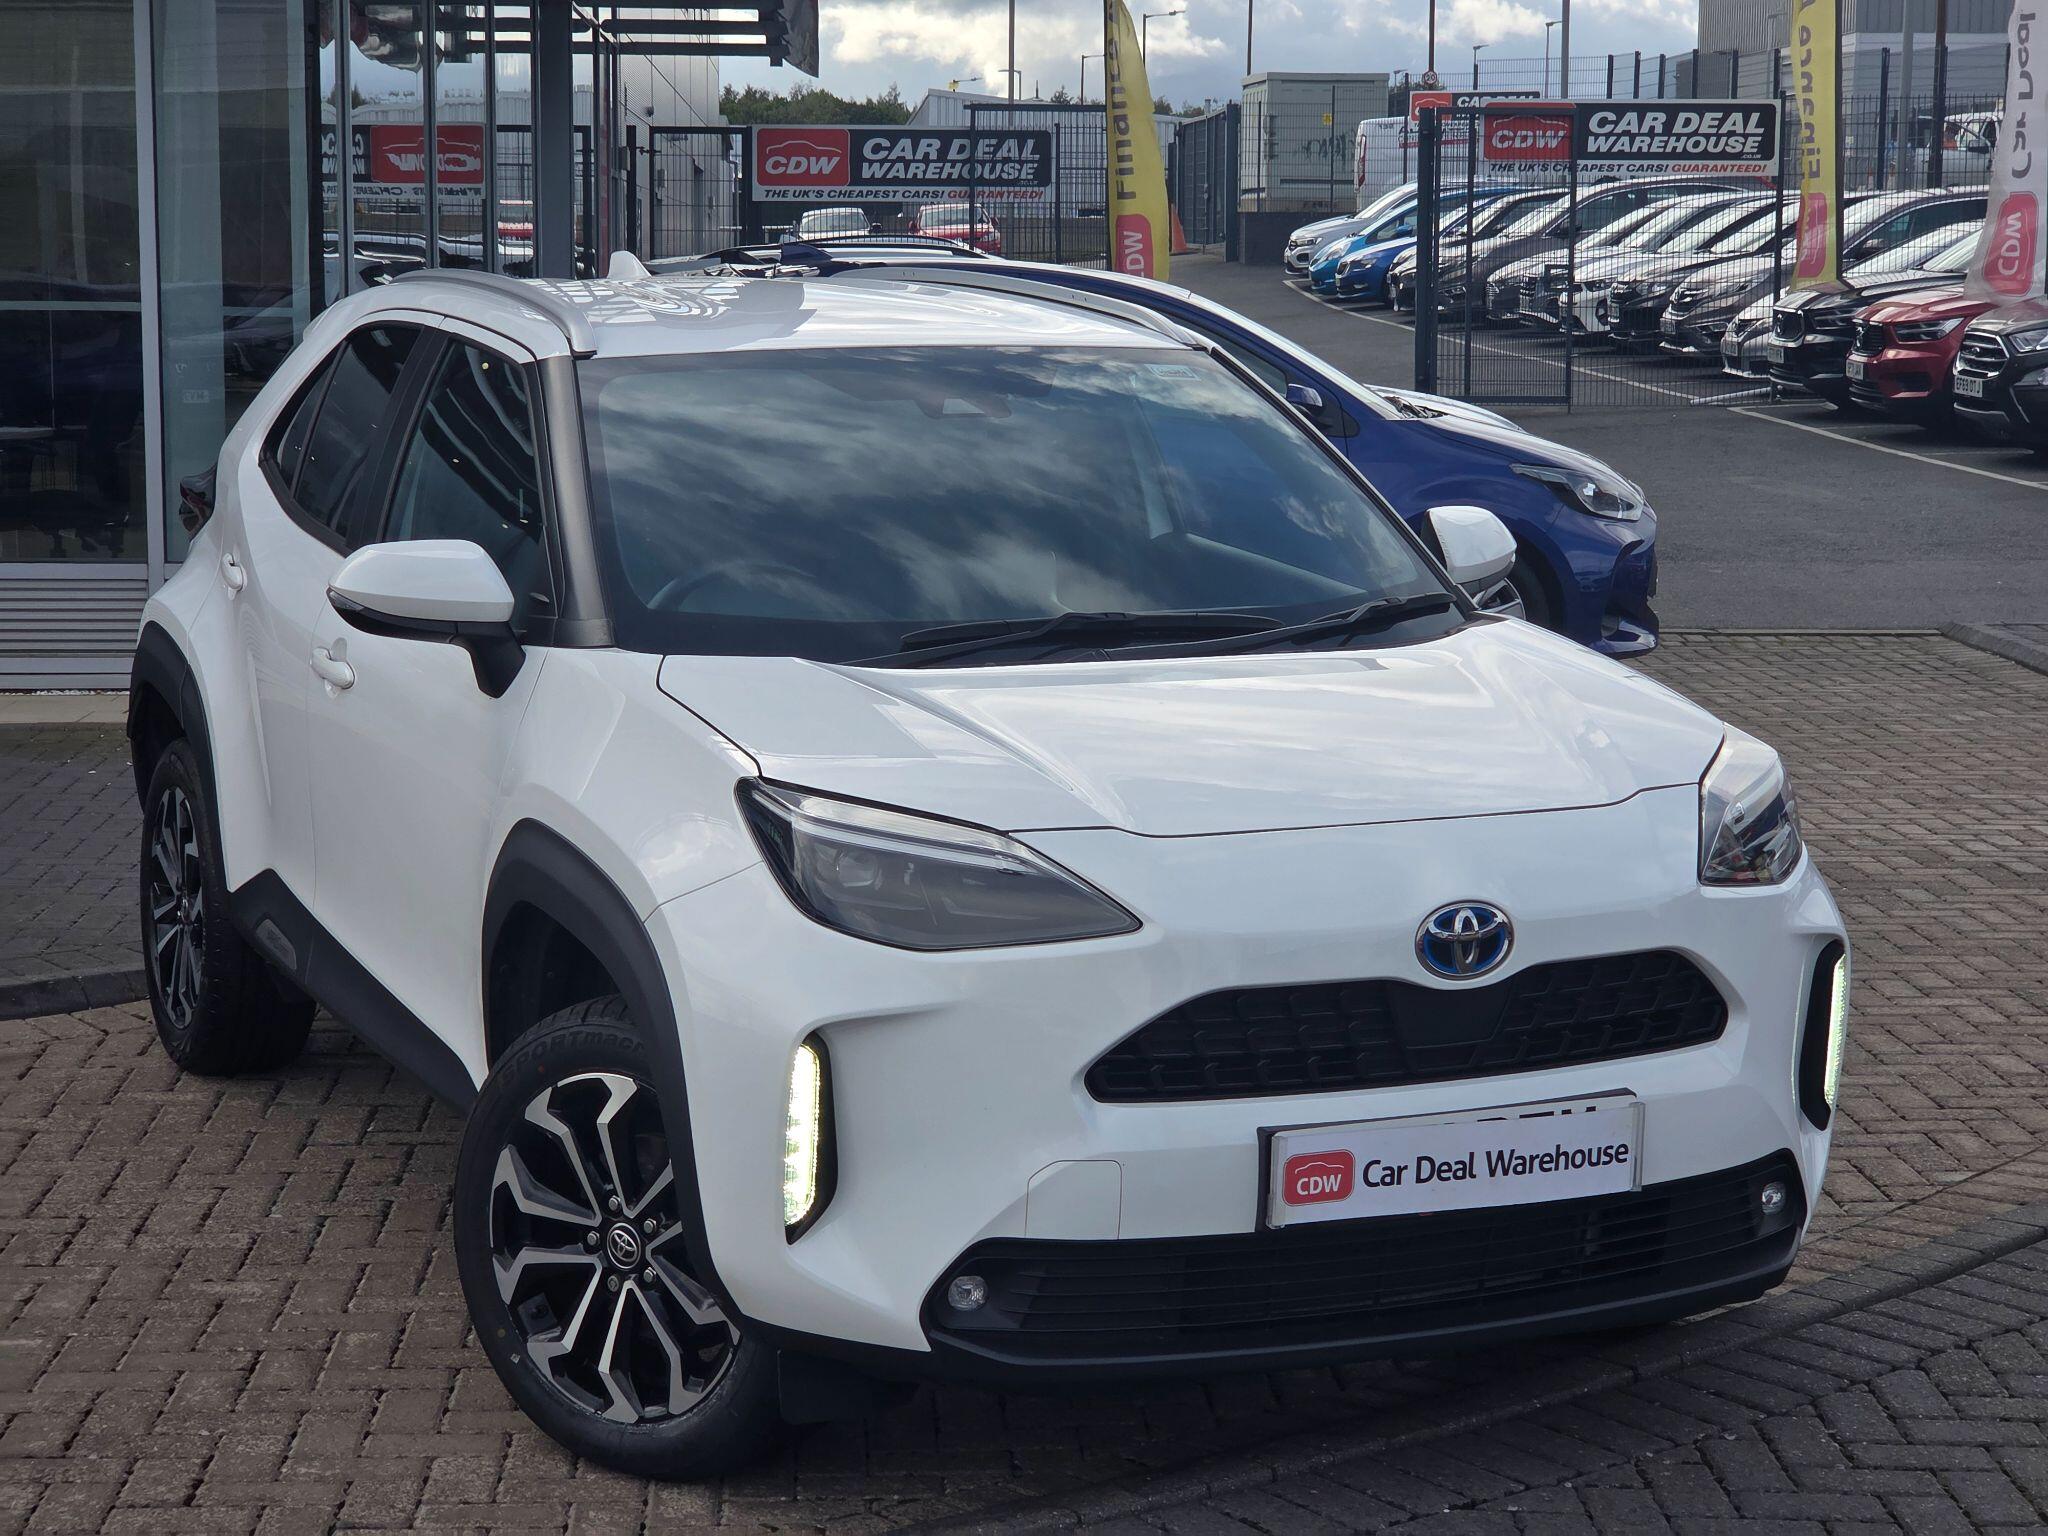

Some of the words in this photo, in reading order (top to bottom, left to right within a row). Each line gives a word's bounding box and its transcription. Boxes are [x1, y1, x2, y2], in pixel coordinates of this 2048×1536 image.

[1588, 111, 1667, 134] CAR
[1671, 111, 1765, 134] DEAL
[862, 138, 942, 160] CAR
[947, 138, 1041, 160] DEAL
[1491, 129, 1567, 149] CDW
[1587, 136, 1763, 154] WAREHOUSE
[765, 156, 841, 176] CDW
[861, 162, 1039, 180] WAREHOUSE
[1490, 163, 1516, 172] THE
[1518, 163, 1550, 172] UK'S
[1552, 163, 1625, 172] CHAPEST
[1625, 163, 1669, 173] CARS!
[1671, 163, 1767, 173] GUARANTEED!
[764, 189, 791, 198] THE
[792, 189, 825, 198] UK'S
[827, 189, 900, 198] CHEAPEST
[901, 189, 945, 198] CARS!
[947, 189, 1044, 199] GURANTEED!
[1123, 231, 1145, 278] DW
[1362, 1159, 1409, 1188] Car
[1415, 1151, 1477, 1184] Deal
[1485, 1142, 1630, 1179] Warehouse
[1296, 1174, 1342, 1196] CDW
